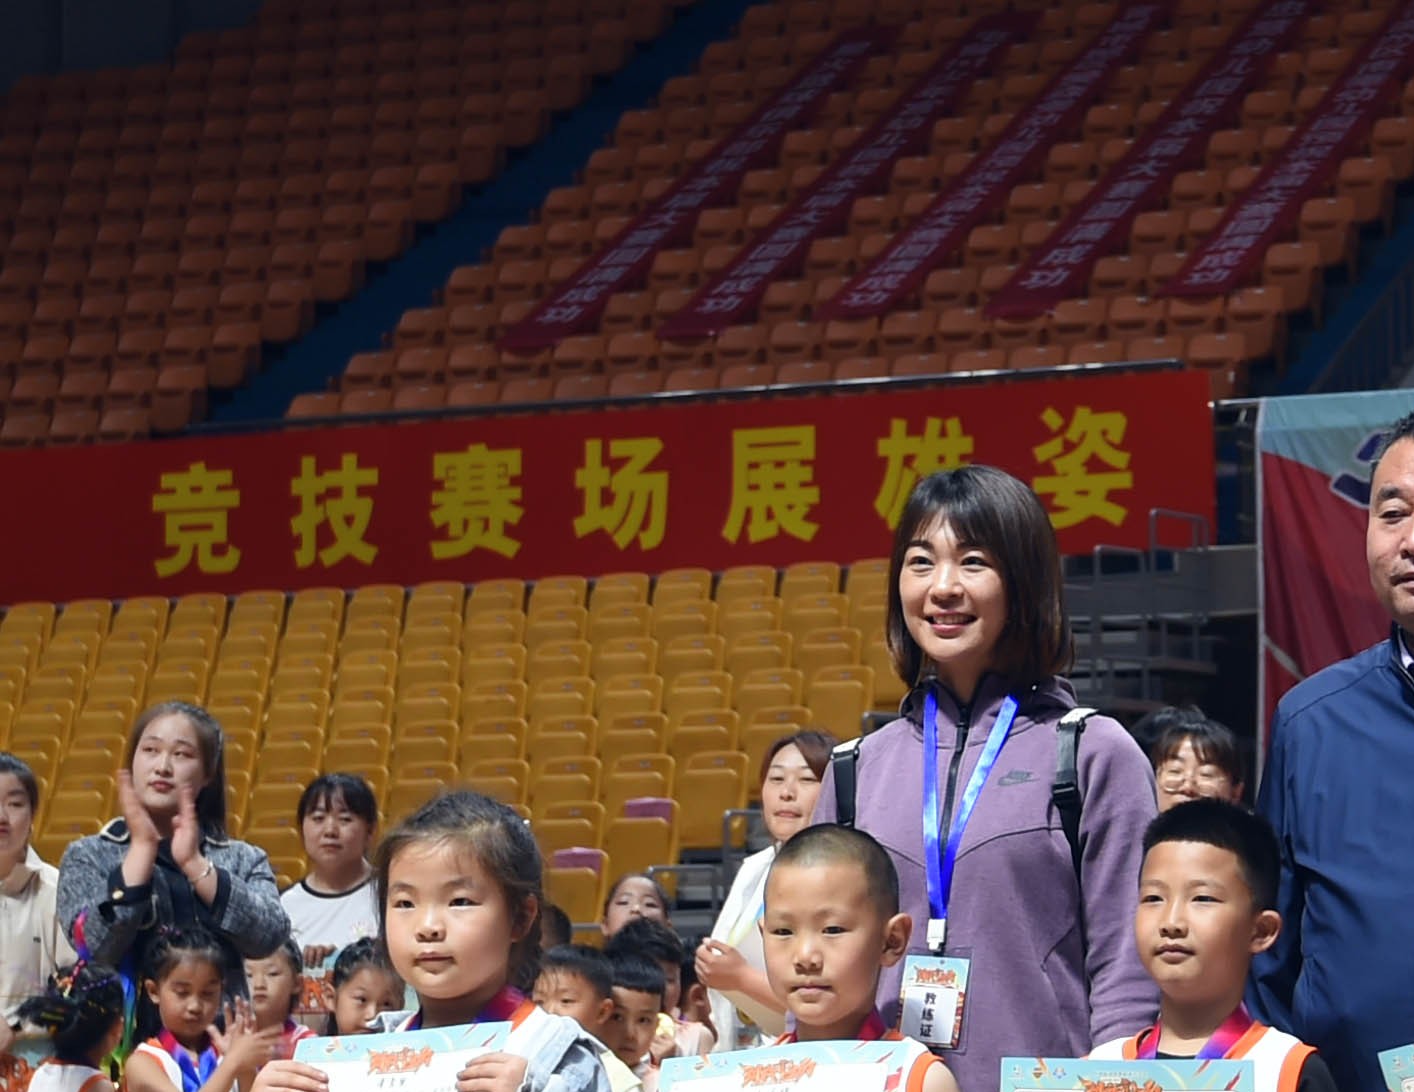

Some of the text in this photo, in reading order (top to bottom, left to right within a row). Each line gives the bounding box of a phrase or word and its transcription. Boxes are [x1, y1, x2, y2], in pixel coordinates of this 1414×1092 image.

[152, 405, 1134, 579] 竞技赛场展雄姿
[919, 992, 937, 1038] 教练证
